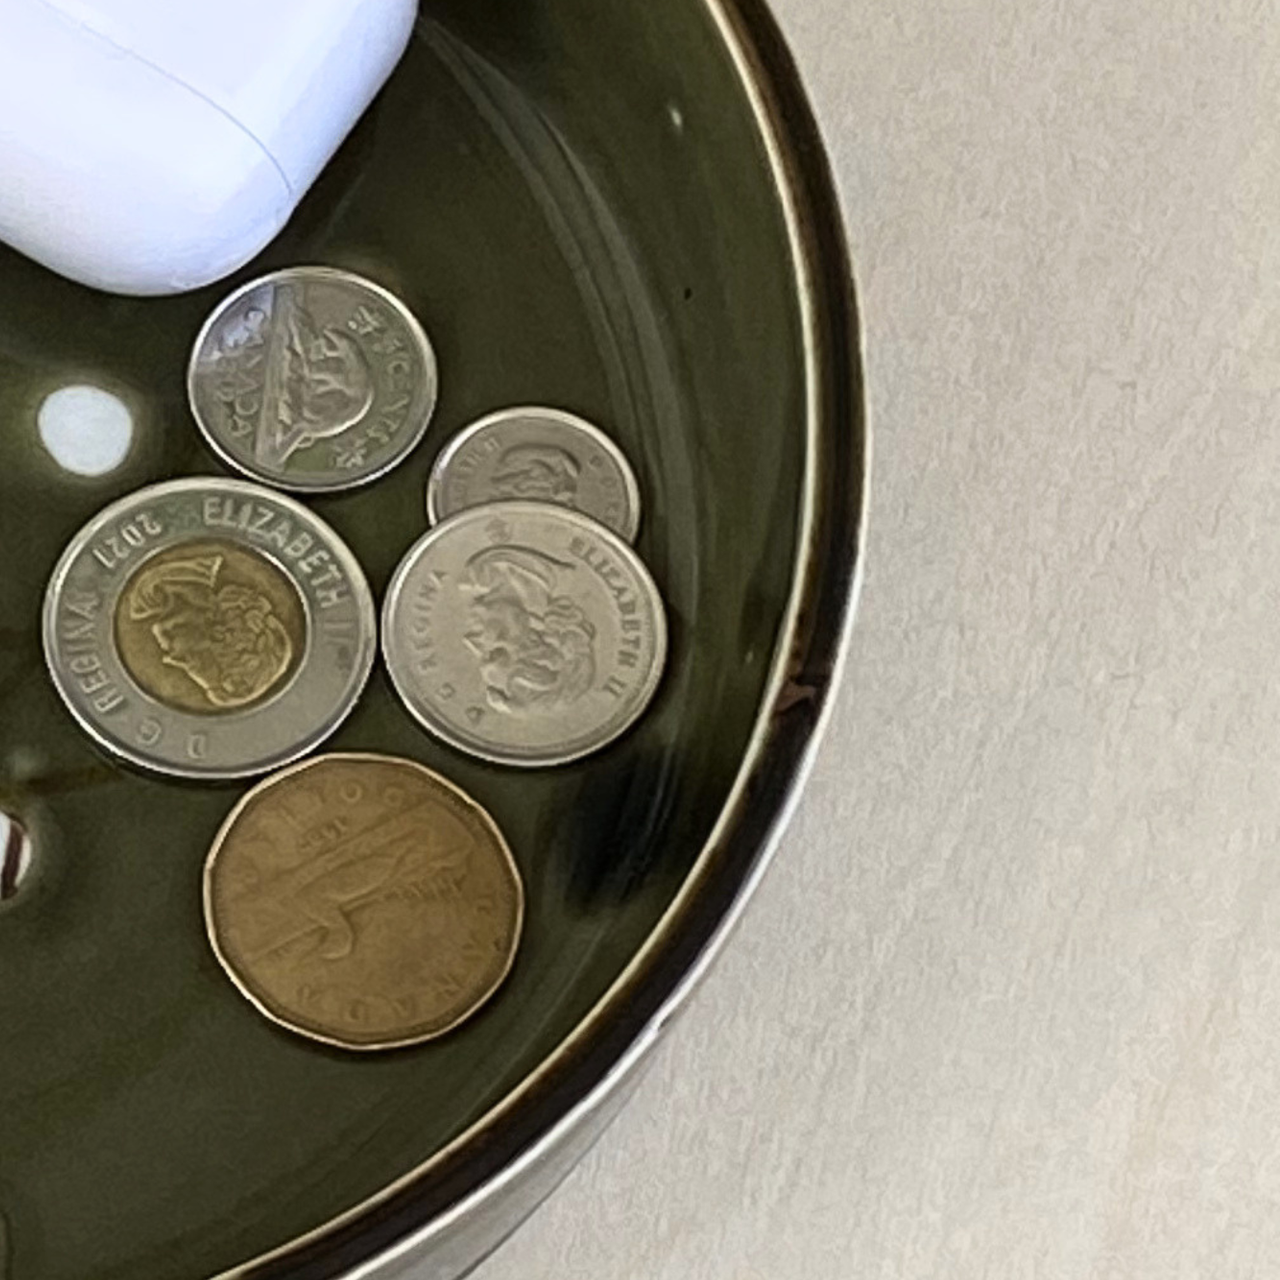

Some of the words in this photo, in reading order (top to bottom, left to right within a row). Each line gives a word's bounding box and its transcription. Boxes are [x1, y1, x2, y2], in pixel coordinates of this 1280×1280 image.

[202, 496, 349, 609] ELIZABETH
[569, 535, 641, 670] ELIZABETH
[62, 590, 125, 714] REGINA
